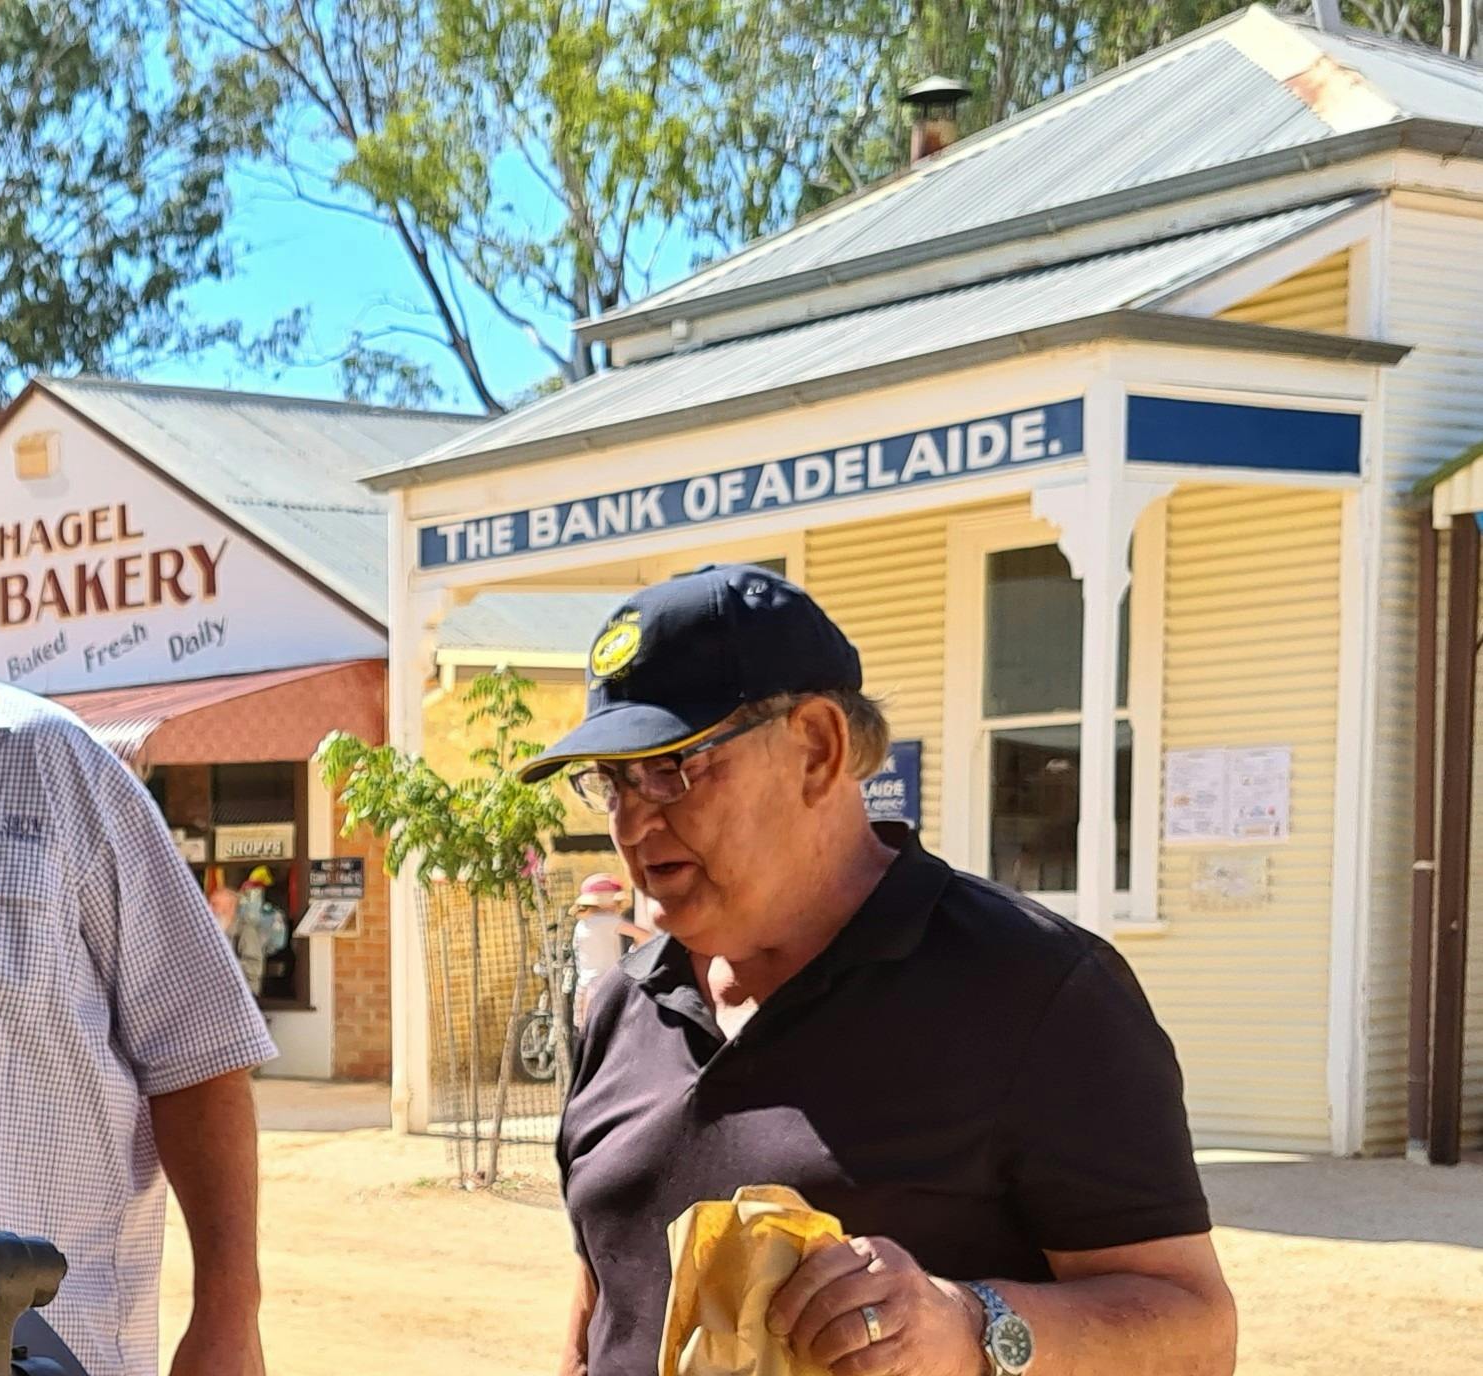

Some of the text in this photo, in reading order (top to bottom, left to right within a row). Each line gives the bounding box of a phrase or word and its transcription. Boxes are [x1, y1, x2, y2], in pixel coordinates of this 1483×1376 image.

[436, 409, 1063, 563] THE BANK OF ADELAIDE.
[7, 614, 230, 682] Baked Fresh Daily
